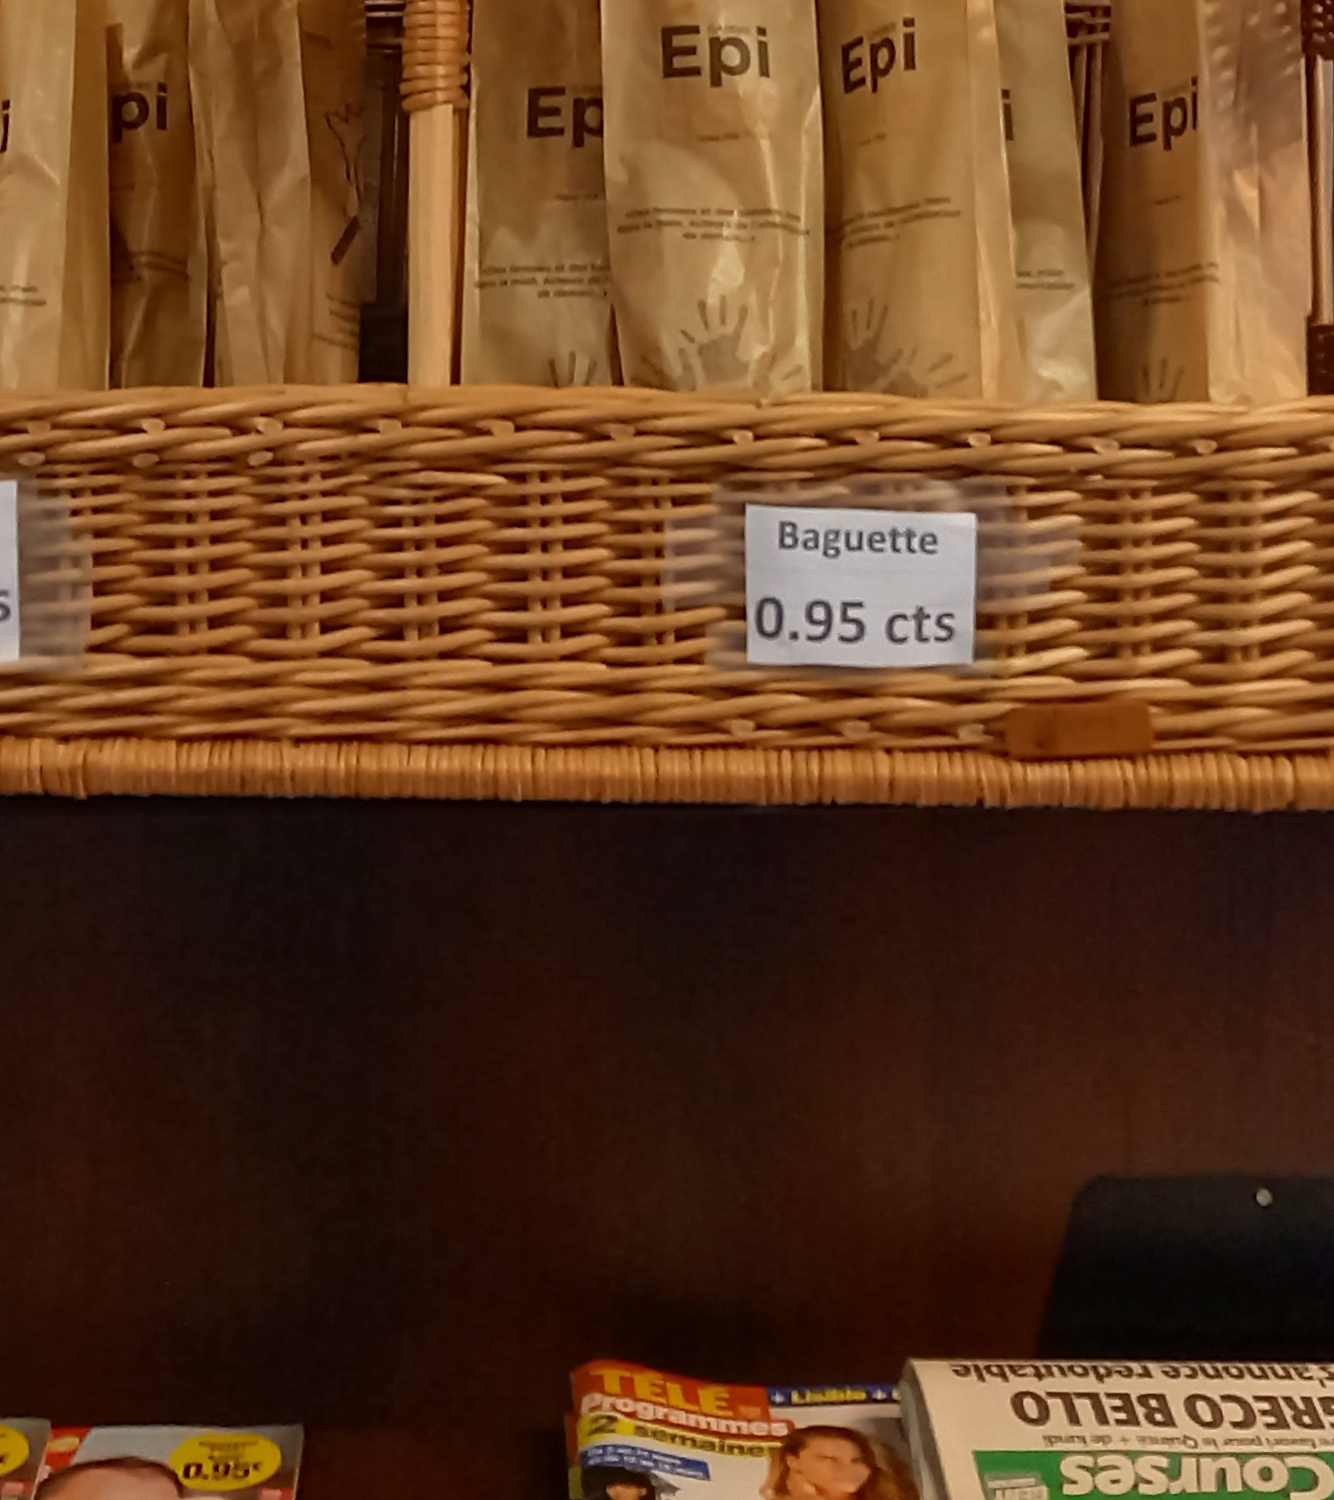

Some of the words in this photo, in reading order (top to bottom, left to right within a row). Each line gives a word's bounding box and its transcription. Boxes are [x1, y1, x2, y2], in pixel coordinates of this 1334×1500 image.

[661, 25, 770, 88] Epi
[841, 17, 917, 93] Epi
[112, 82, 167, 143] pi
[1129, 76, 1198, 152] Epi
[777, 520, 939, 559] Baguette
[755, 596, 867, 644] 0.95
[885, 605, 956, 645] cts
[951, 1362, 1155, 1384] redoutable
[1009, 1391, 1179, 1429] BELLO
